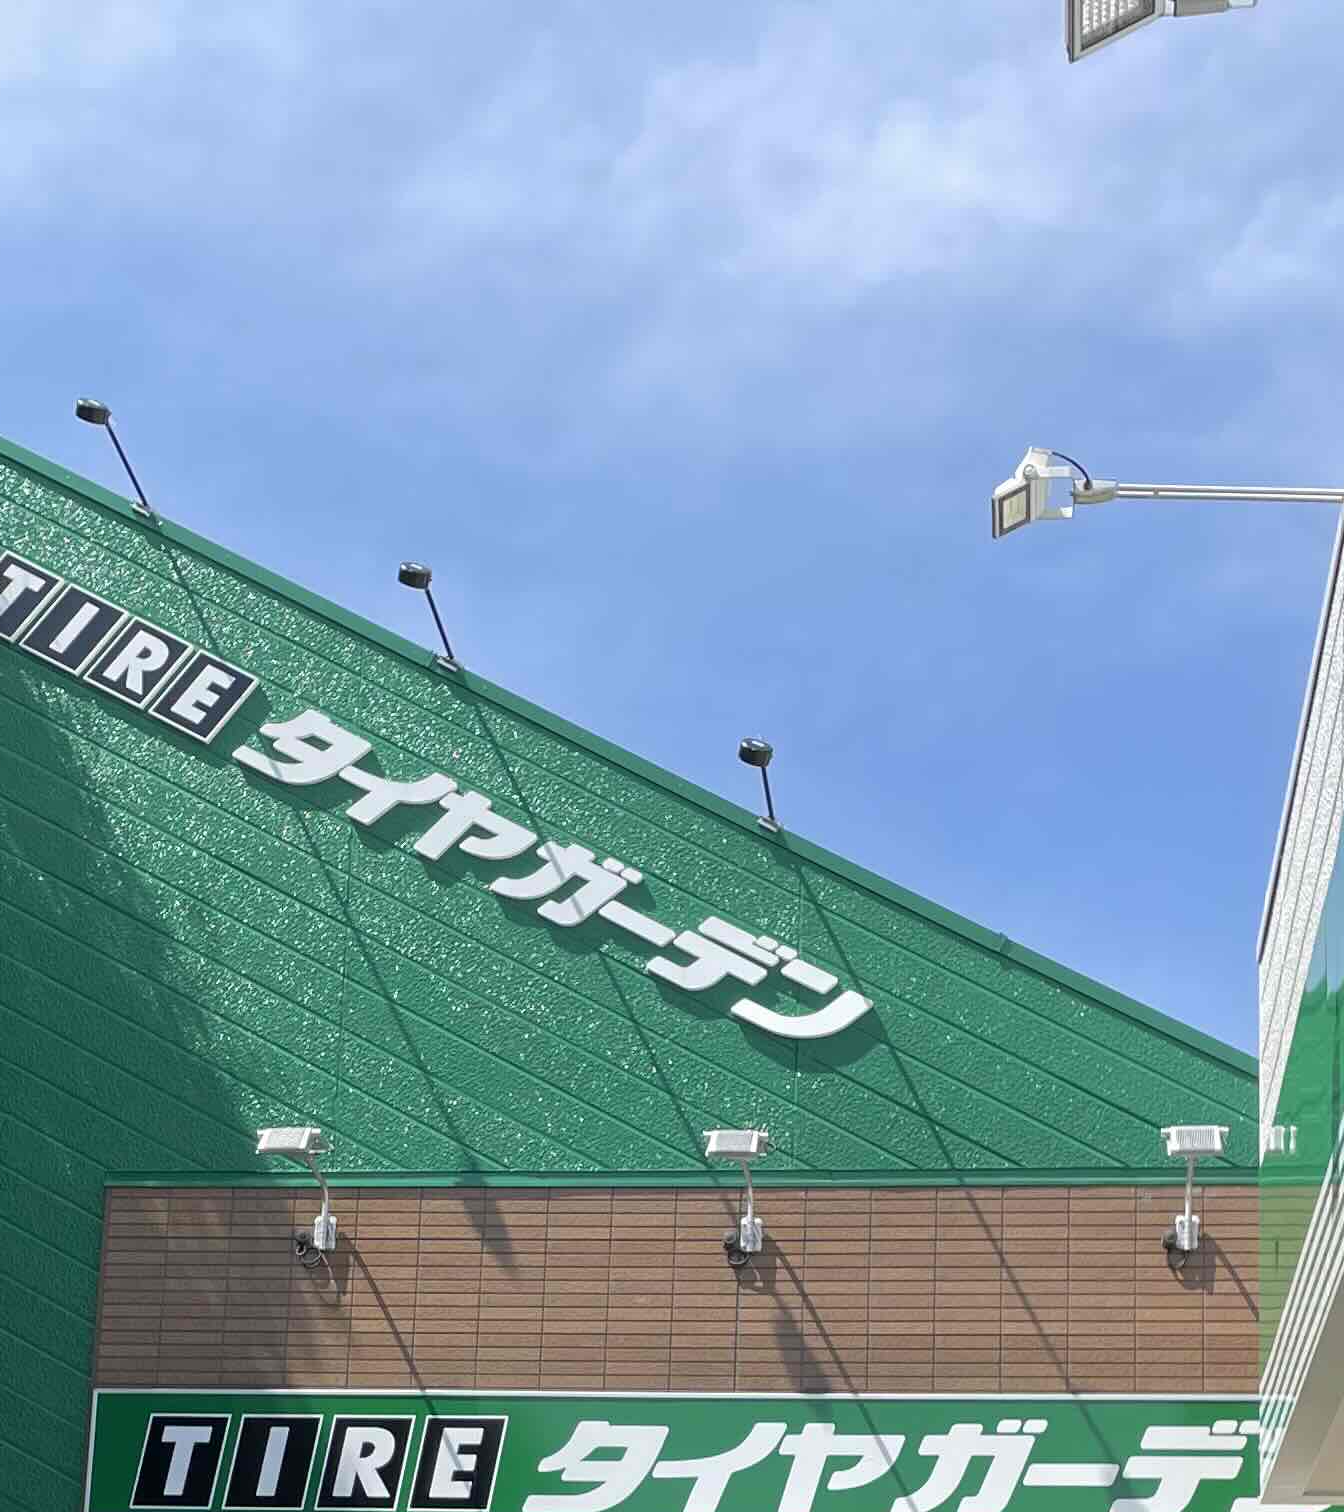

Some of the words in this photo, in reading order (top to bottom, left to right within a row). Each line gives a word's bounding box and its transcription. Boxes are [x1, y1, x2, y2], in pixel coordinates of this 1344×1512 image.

[232, 708, 873, 1039] タイヤガーデン
[161, 1426, 484, 1498] TIRE
